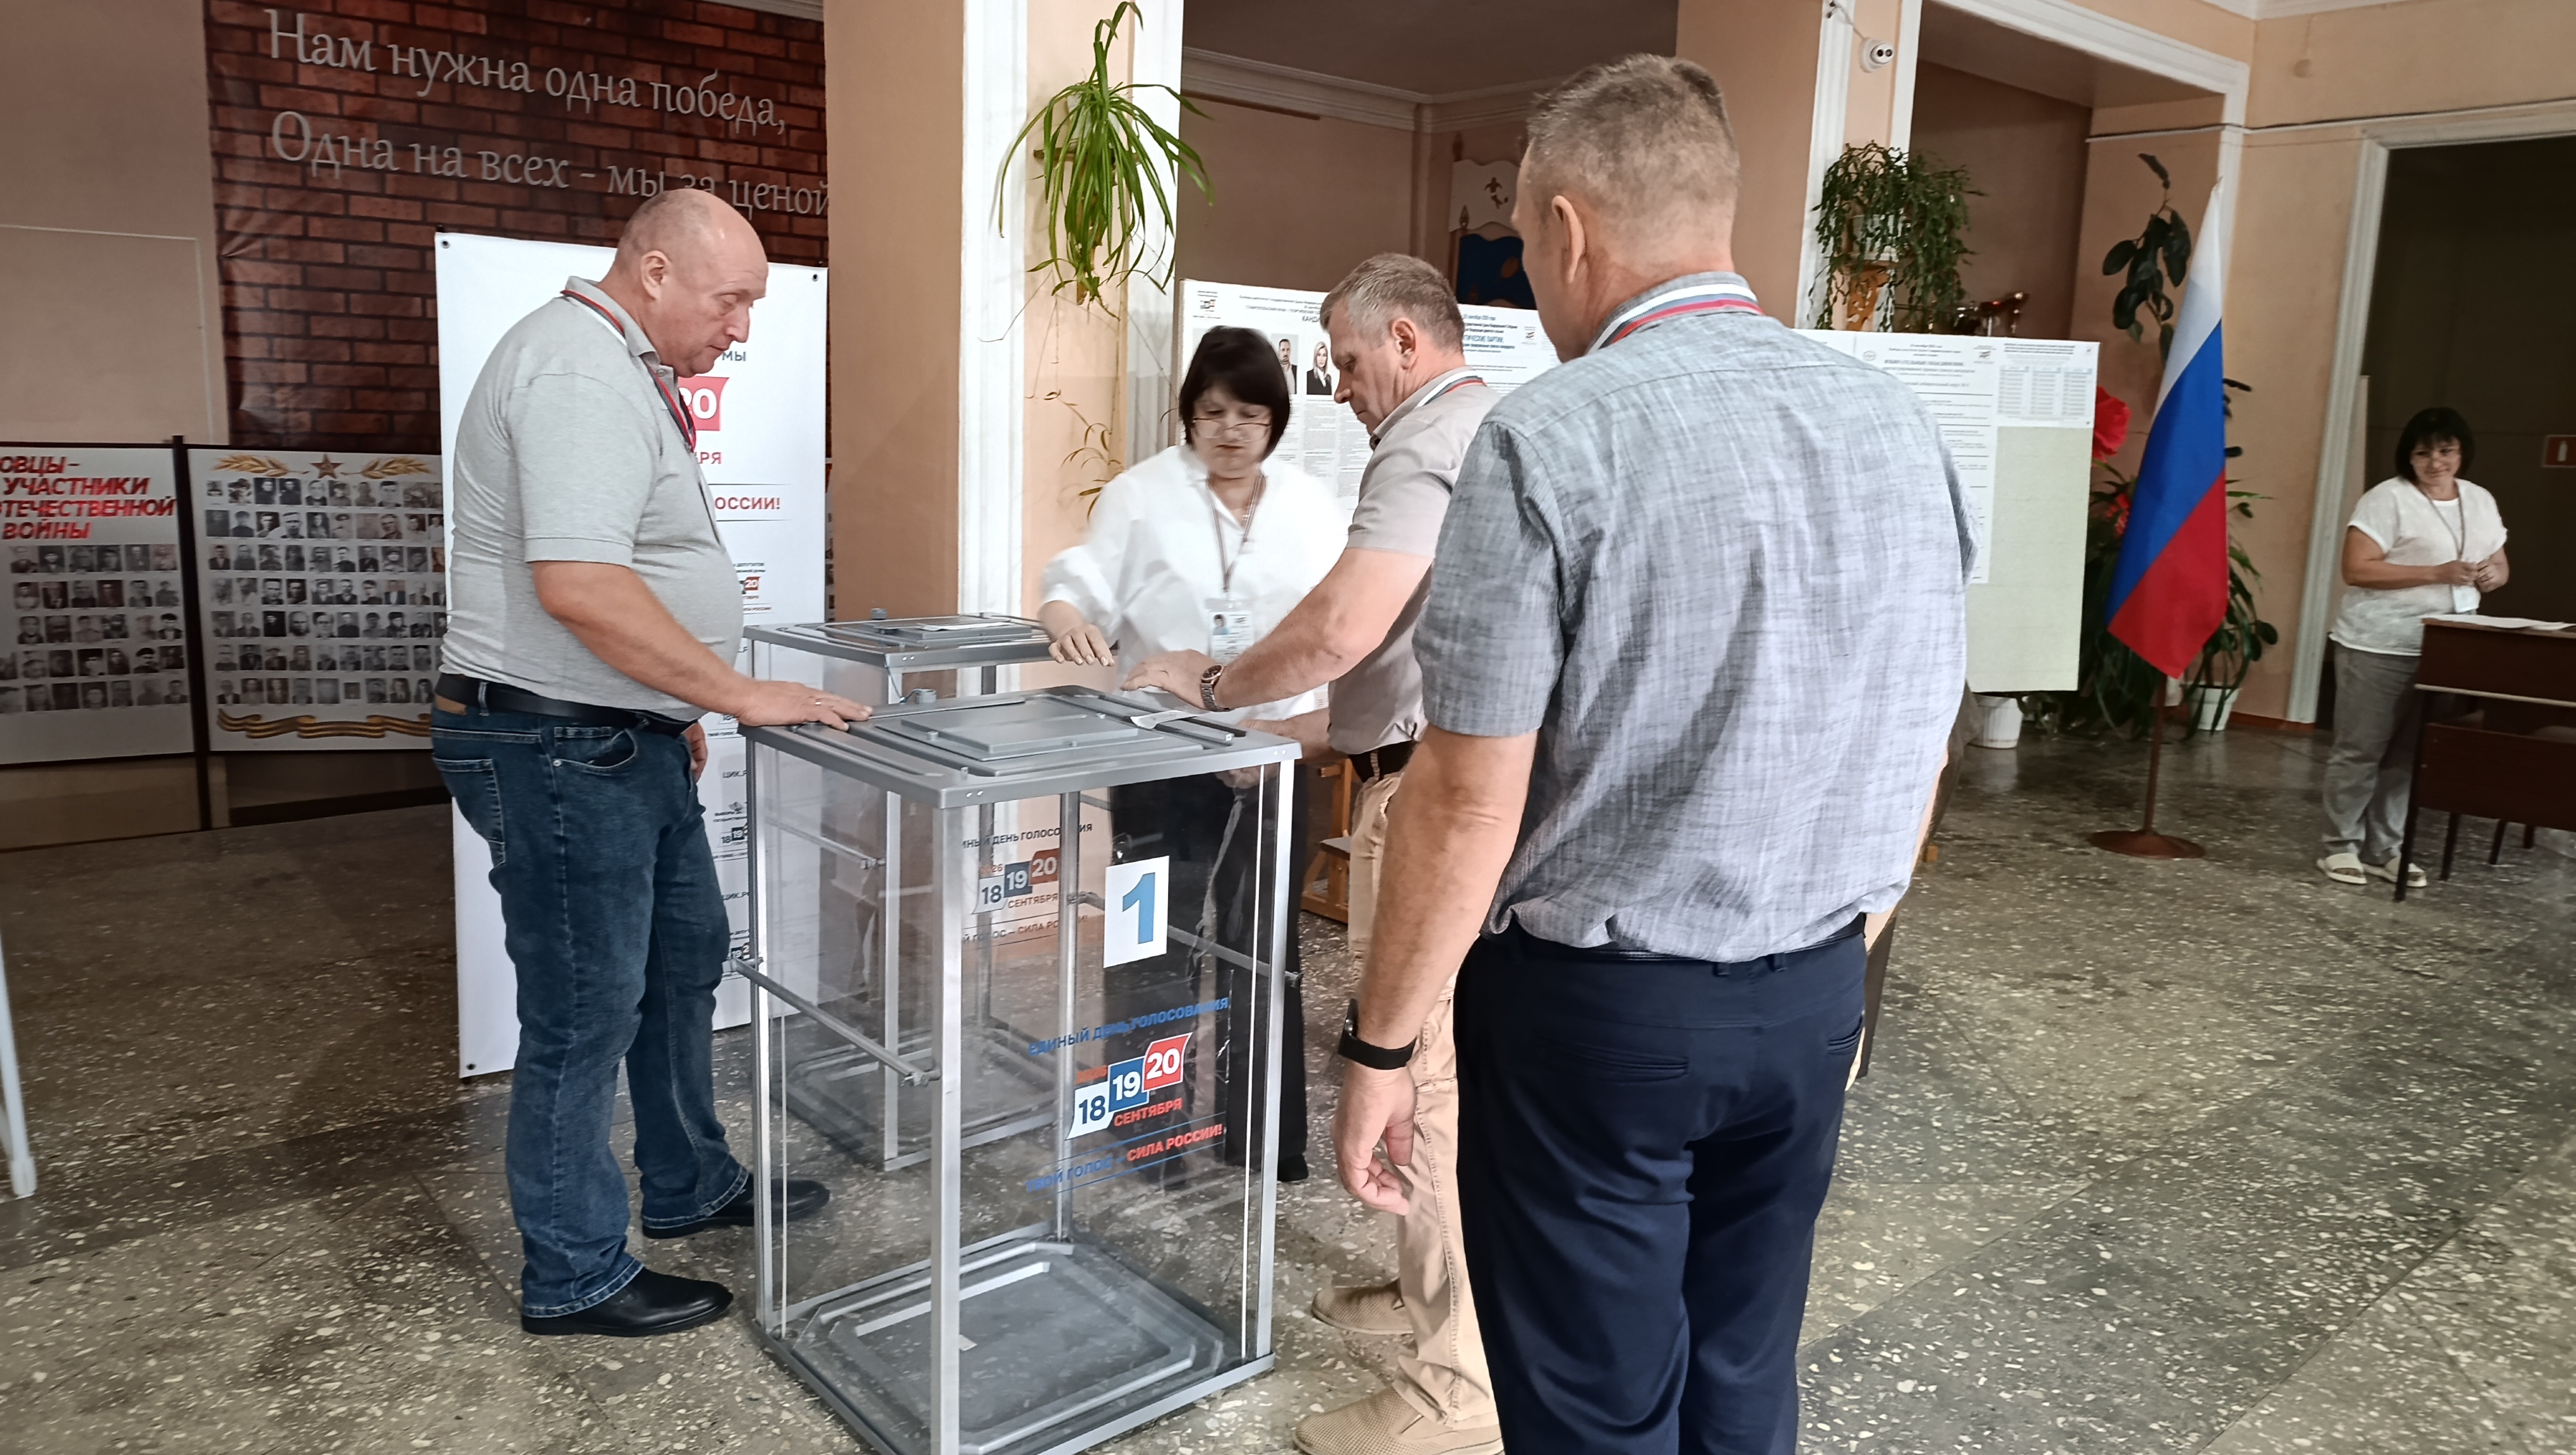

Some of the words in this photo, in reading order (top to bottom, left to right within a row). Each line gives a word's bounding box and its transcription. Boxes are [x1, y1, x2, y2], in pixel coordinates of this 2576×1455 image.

[263, 9, 377, 73] Нам
[386, 42, 535, 97] нужна
[545, 66, 641, 114] одна
[650, 69, 785, 135] победа,
[271, 111, 400, 179] Одна
[410, 141, 468, 179] на
[480, 149, 569, 189] всех
[607, 165, 665, 198] мы
[728, 181, 828, 220] ценой
[722, 351, 746, 362] МЫ
[3, 477, 151, 496] УЧАСТНИКИ
[0, 495, 177, 518] ТЕЧЕСТВЕННОЙ
[715, 496, 780, 510] ОССИИ!
[3, 518, 91, 540] ВОЙНЫ
[993, 834, 1019, 845] ДЕНЬ
[1020, 823, 1093, 841] ГОЛОСОИЯ
[982, 885, 1002, 904] 18
[1006, 870, 1029, 890] 19
[1032, 856, 1058, 878] 20
[1008, 892, 1059, 909] СЕНТЯБРЯ
[1121, 872, 1156, 945] 1
[1018, 923, 1043, 935] СИЛА
[1029, 1027, 1089, 1057] ЕДИНЫЙ
[1093, 1021, 1130, 1039] ДЕНЬ
[1130, 997, 1230, 1029] ГОЛОСОВАНИЯ
[1078, 1095, 1106, 1125] 18
[1112, 1071, 1141, 1101] 19
[1146, 1048, 1181, 1080] 20
[1113, 1097, 1183, 1127] СЕНТЯБРЯ
[1025, 1169, 1064, 1193] ТВОЙ
[1067, 1154, 1114, 1180] ГОЛОС
[1126, 1141, 1164, 1161] СИЛА
[1166, 1123, 1223, 1150] РОССИИ!
